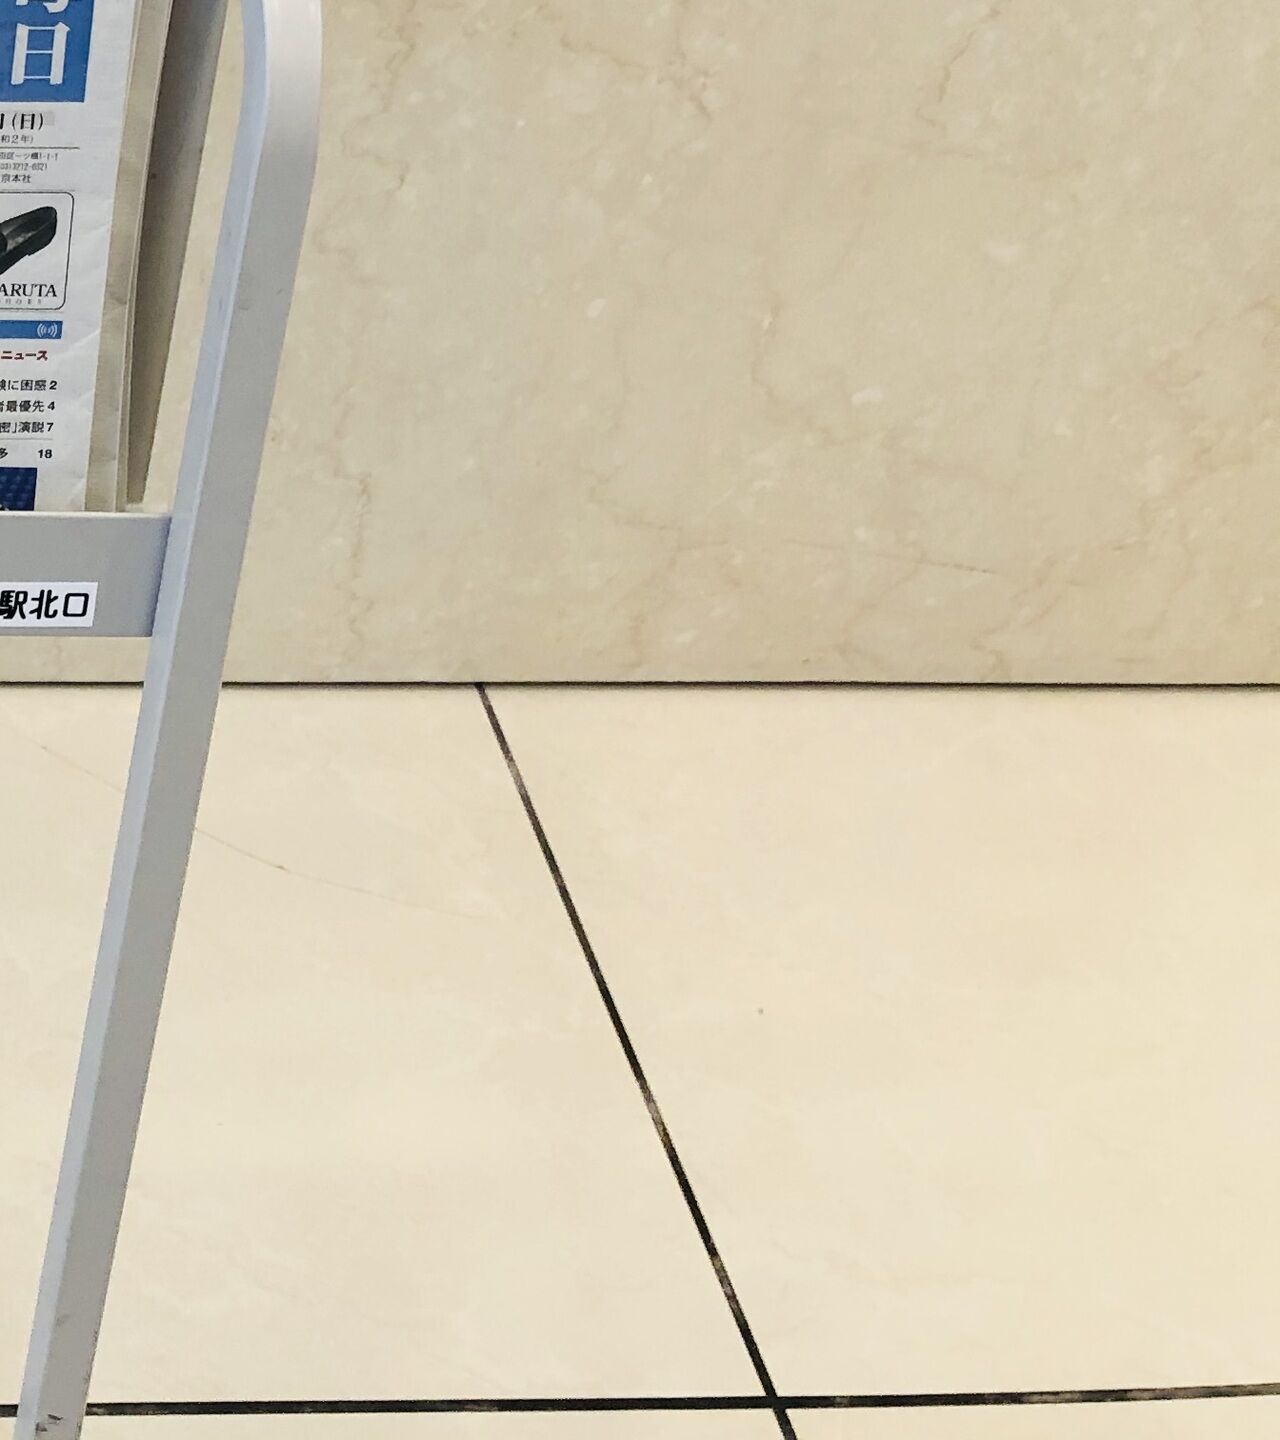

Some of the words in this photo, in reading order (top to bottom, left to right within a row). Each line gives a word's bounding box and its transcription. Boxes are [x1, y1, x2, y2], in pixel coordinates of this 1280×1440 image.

[49, 380, 58, 391] 2
[47, 401, 55, 411] 4
[46, 422, 54, 432] 7
[37, 449, 53, 459] 18
